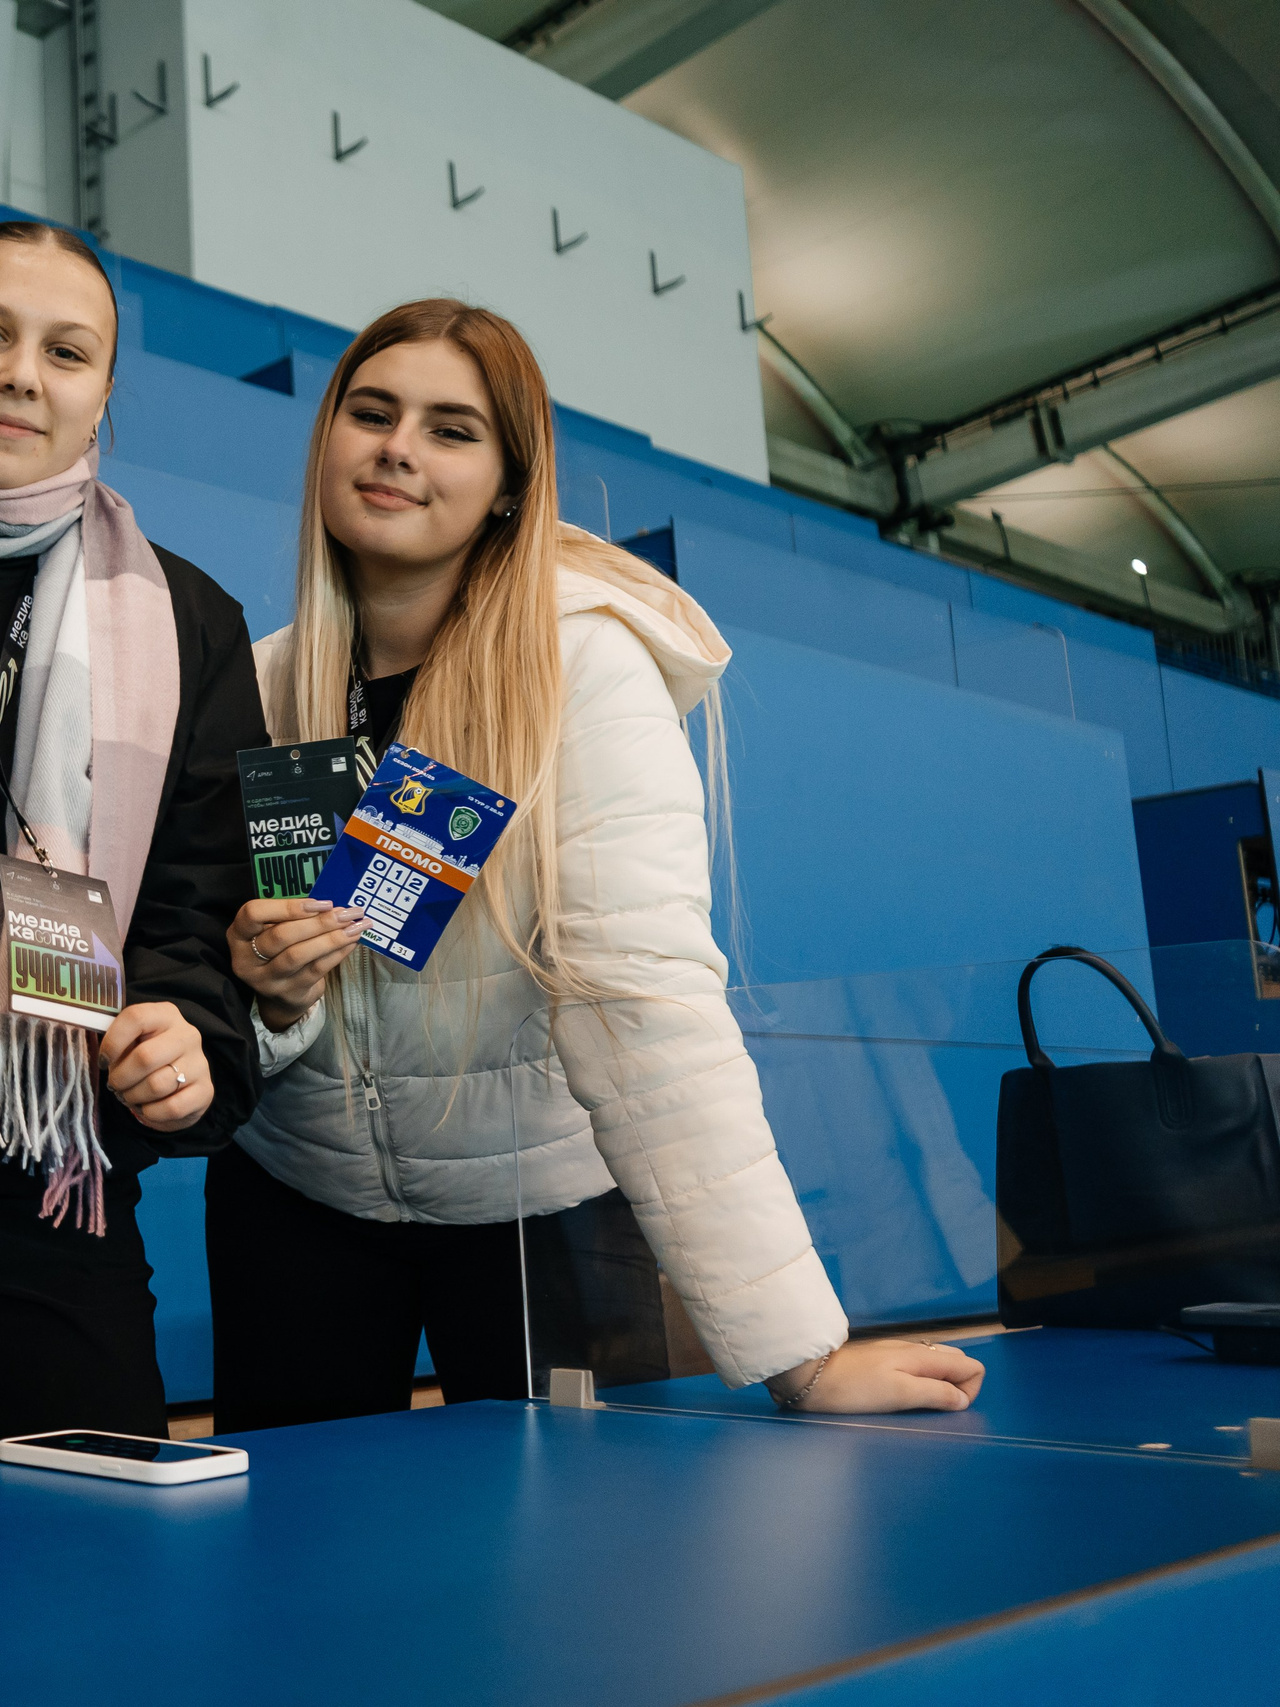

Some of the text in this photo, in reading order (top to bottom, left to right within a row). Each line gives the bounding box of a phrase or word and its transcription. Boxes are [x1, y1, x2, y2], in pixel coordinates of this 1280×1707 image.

[7, 594, 34, 641] медиа
[249, 812, 322, 834] медиа
[374, 832, 444, 877] ПРОМО
[258, 849, 331, 899] УЧАСТ
[361, 875, 377, 890] 3
[371, 857, 424, 891] 0 1 2
[351, 893, 367, 908] 6
[8, 910, 81, 938] медиа
[361, 929, 408, 956] МИР 31
[15, 946, 118, 1009] УЧАСТНИК
